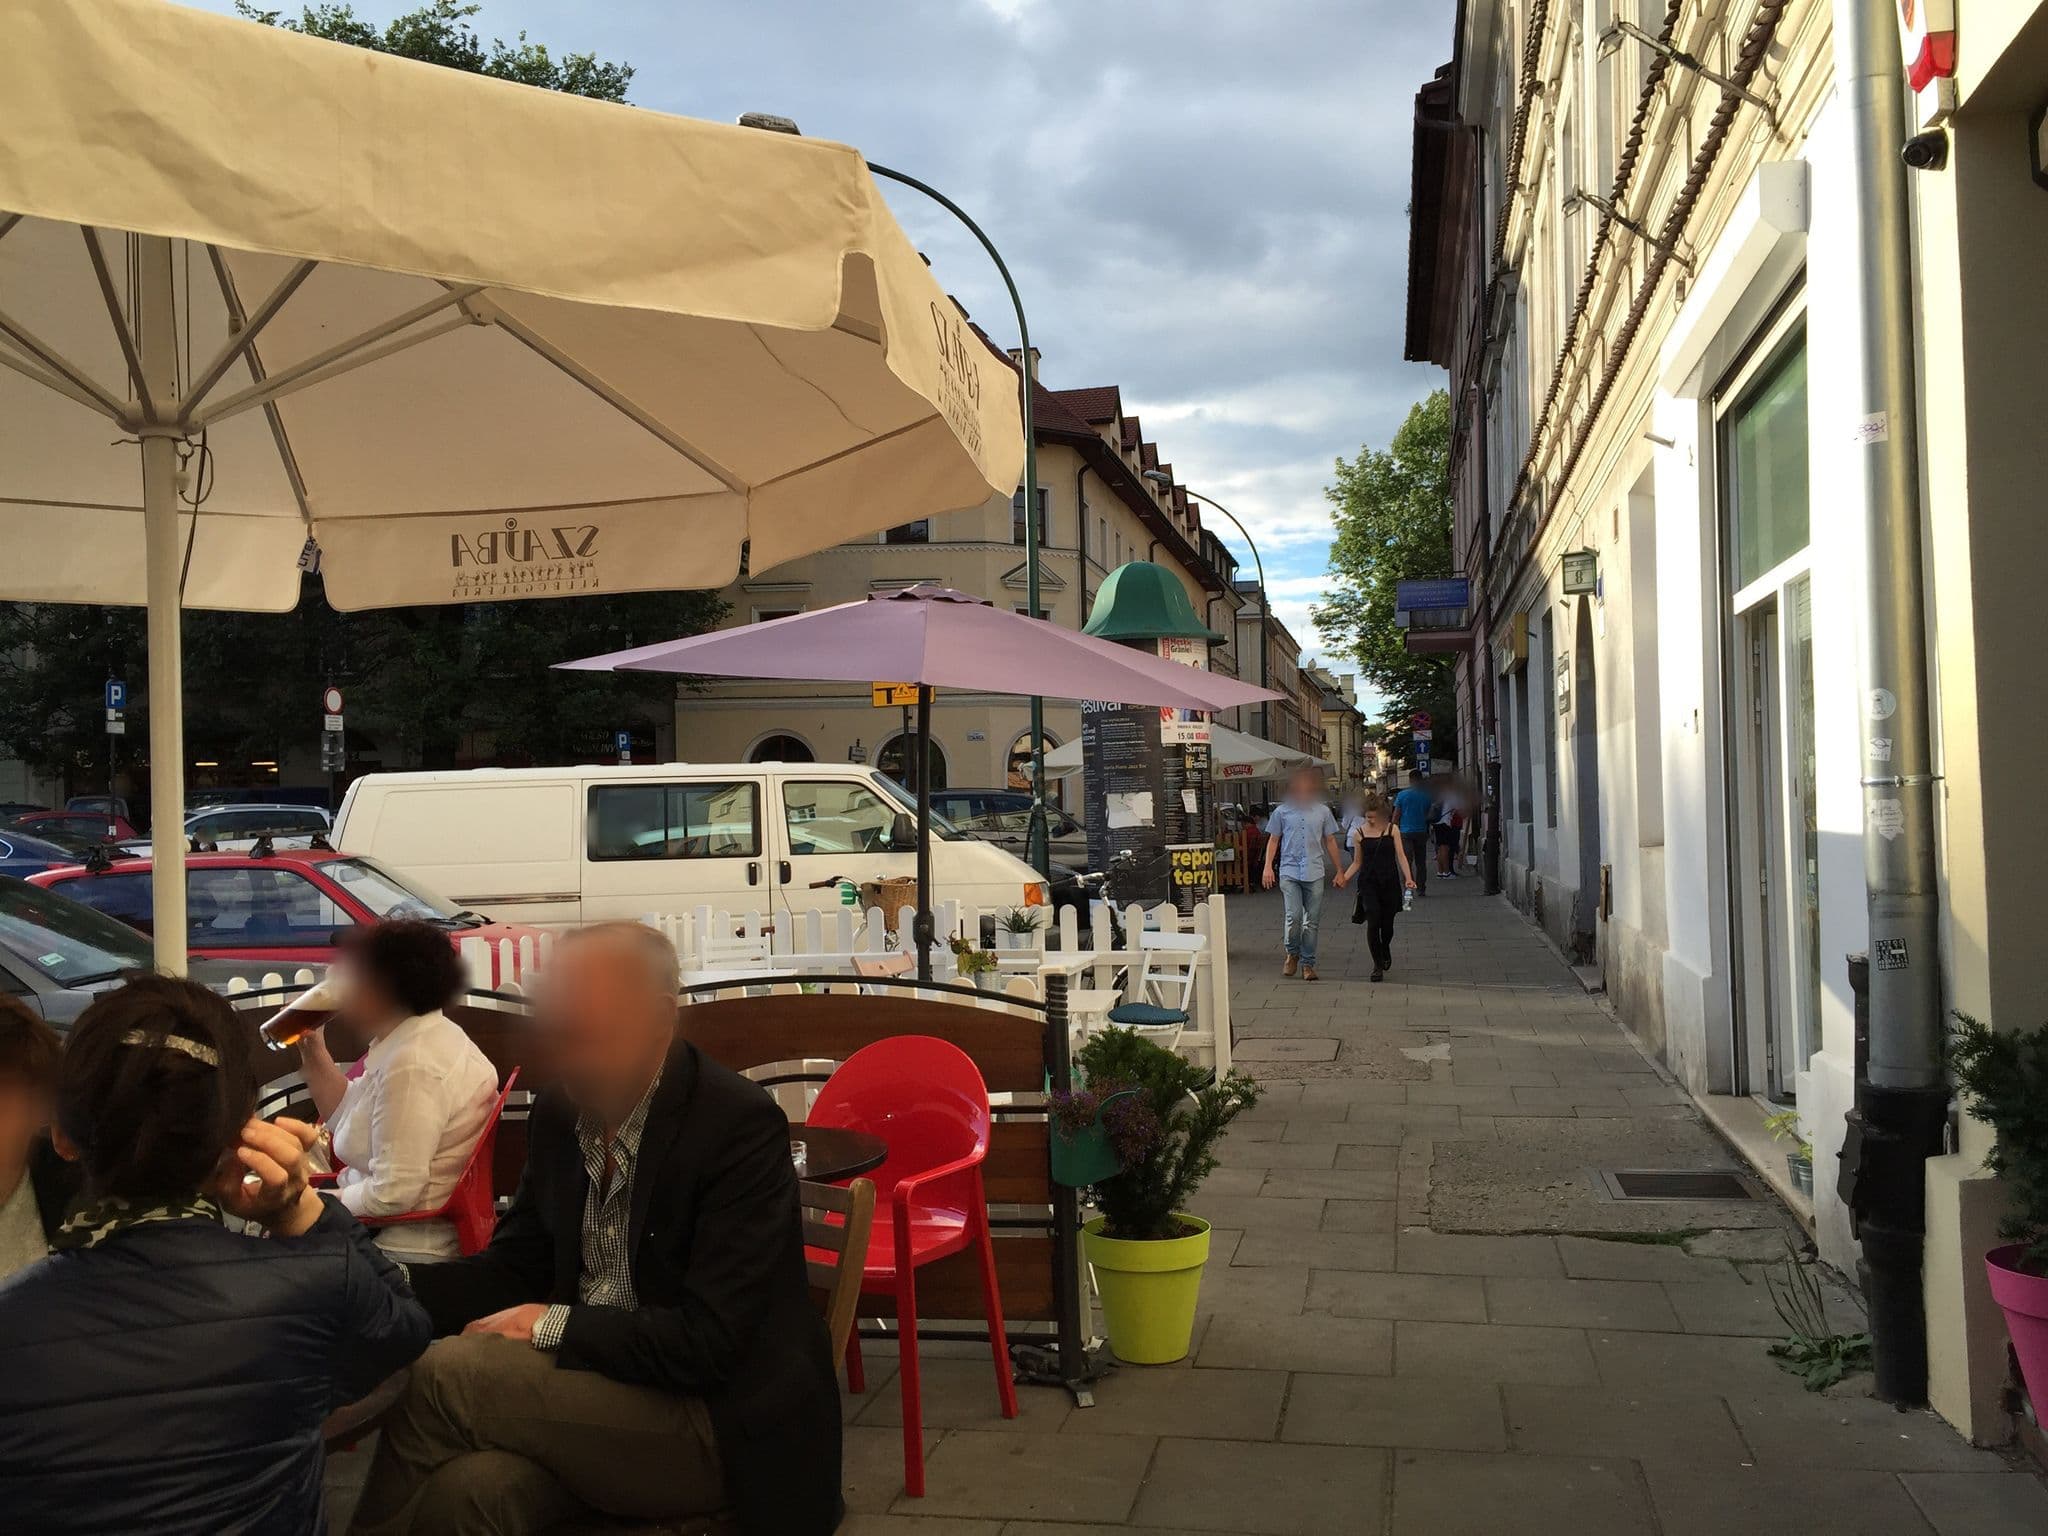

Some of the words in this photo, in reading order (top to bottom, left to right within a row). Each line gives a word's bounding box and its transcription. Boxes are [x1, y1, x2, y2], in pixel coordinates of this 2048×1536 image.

[111, 685, 122, 705] P
[618, 733, 628, 748] P
[1419, 761, 1428, 770] P
